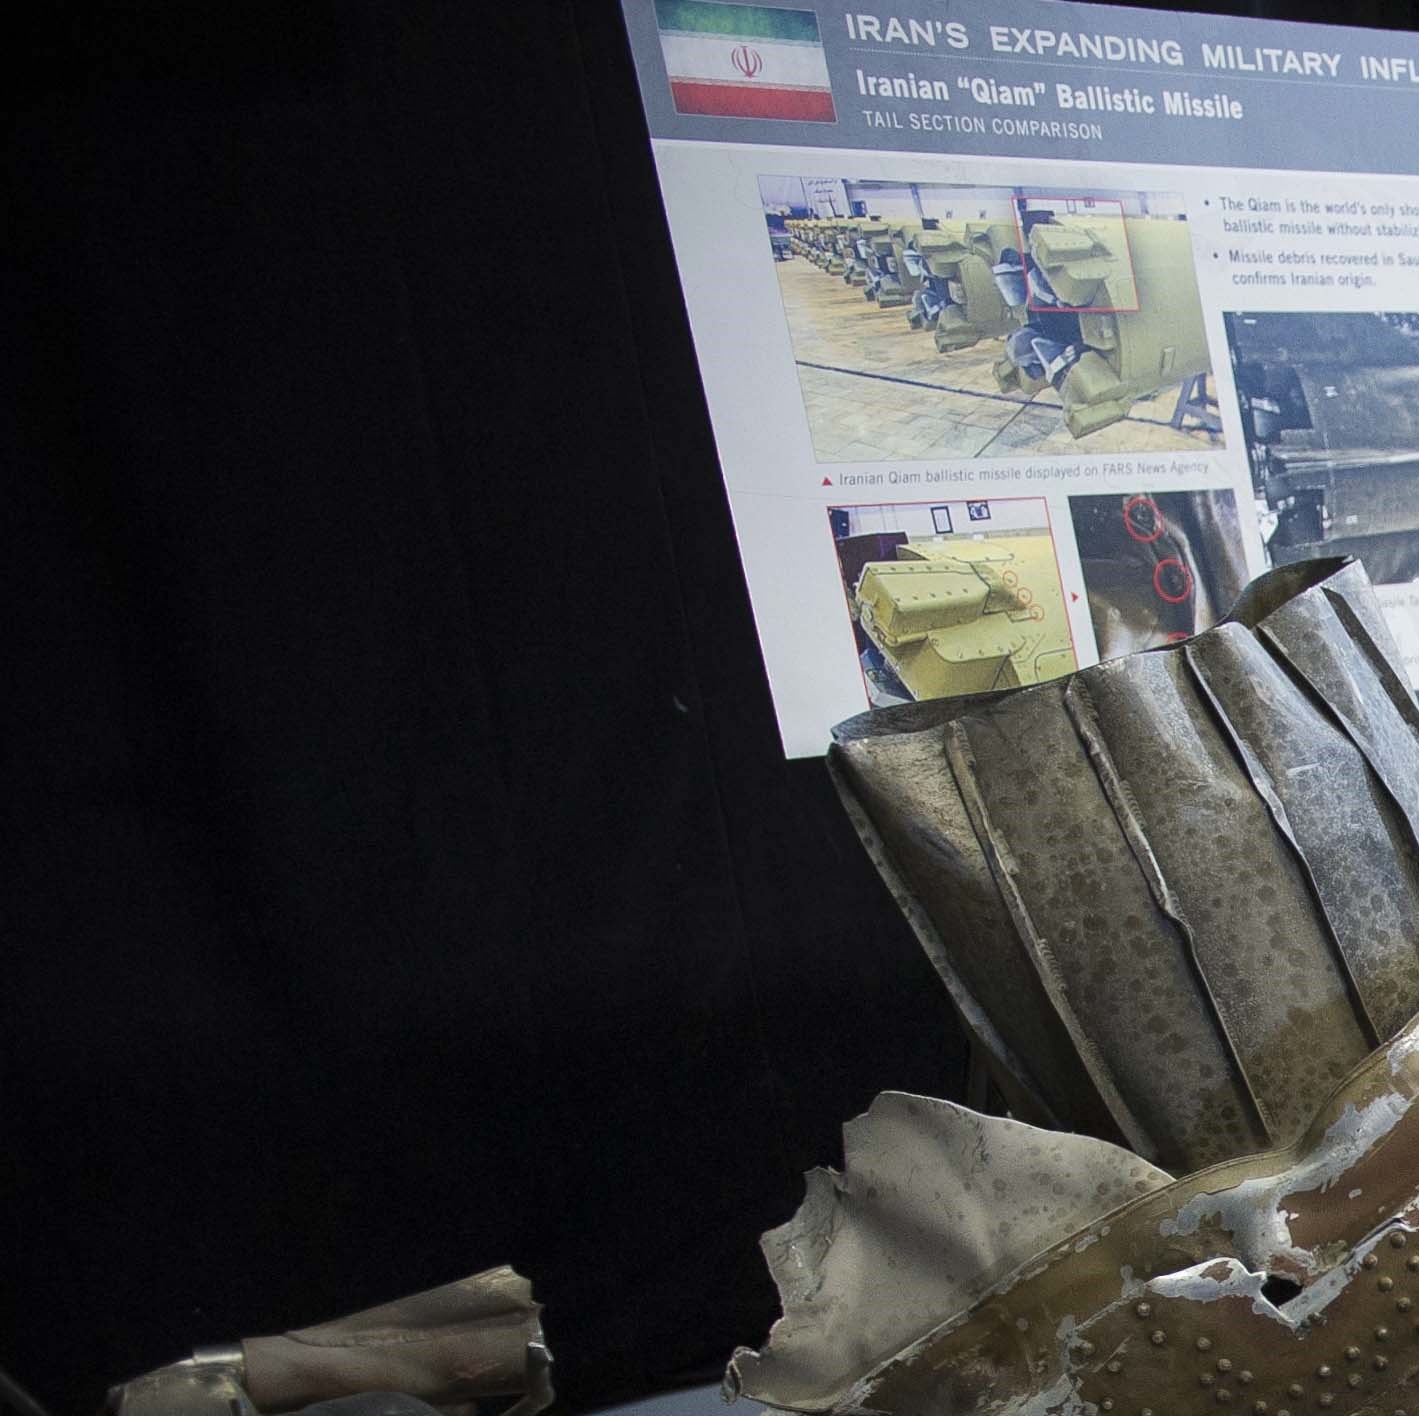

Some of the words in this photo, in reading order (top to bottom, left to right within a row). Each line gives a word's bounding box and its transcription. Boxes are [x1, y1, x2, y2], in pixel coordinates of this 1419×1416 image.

[845, 13, 969, 49] IRAN'S
[989, 25, 1185, 66] EXPANDING
[1200, 43, 1341, 77] MILITARY
[856, 69, 950, 101] Iranian
[958, 76, 1045, 107] “Qiam”
[1056, 83, 1155, 114] Ballistic
[1163, 90, 1244, 120] Missile
[862, 110, 903, 129] TAIL
[909, 113, 986, 133] SECTION
[993, 119, 1103, 140] COMPARISON
[1219, 196, 1244, 211] The
[1248, 197, 1281, 213] Qiam
[1286, 199, 1297, 213] is
[1300, 200, 1320, 214] the
[1326, 201, 1367, 215] world's
[1370, 203, 1395, 218] only
[1224, 219, 1274, 233] ballistic
[1279, 222, 1322, 235] missile
[1327, 222, 1372, 236] without
[1229, 249, 1273, 264] Missile
[1278, 251, 1316, 265] debris
[1320, 252, 1378, 266] recovered
[1382, 254, 1395, 266] in
[1232, 271, 1287, 286] confirms
[1291, 272, 1335, 287] Iranian
[839, 472, 884, 486] Iranian
[888, 471, 921, 485] Qiam
[925, 469, 975, 483] ballistic
[979, 467, 1021, 481] missile
[1025, 465, 1080, 481] displayed
[1084, 466, 1098, 477] on
[1103, 463, 1133, 476] FARS
[1137, 462, 1167, 475] News
[1170, 460, 1209, 476] Agency
